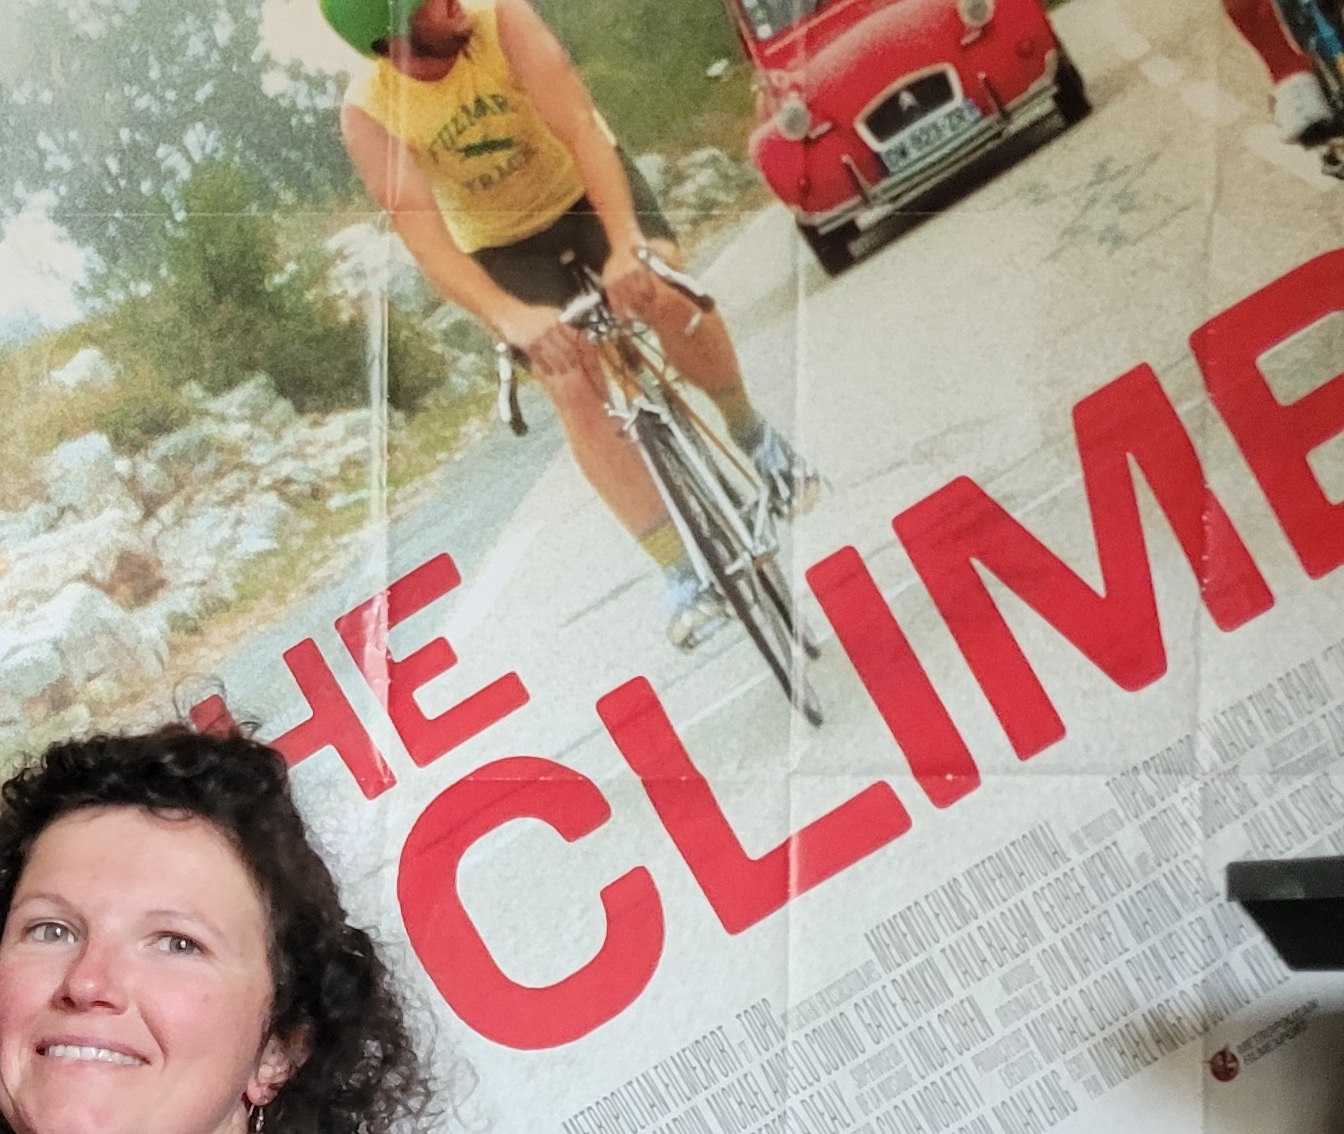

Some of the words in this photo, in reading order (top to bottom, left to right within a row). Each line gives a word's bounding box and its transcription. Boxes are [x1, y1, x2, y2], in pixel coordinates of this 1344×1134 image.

[189, 552, 530, 800] HE
[1103, 763, 1158, 824] TOPIC
[862, 899, 941, 975] MEMENTO
[923, 875, 980, 938] FILMS
[960, 818, 1072, 914] INTERNATIONAL
[1032, 941, 1078, 997] JON
[1058, 908, 1130, 980] NATCHEZ
[1114, 875, 1182, 945] MARTIN
[755, 1037, 822, 1107] ANGELO
[802, 1009, 867, 1077] COVINO
[851, 983, 909, 1047] GAYLE
[889, 954, 955, 1023] RANKIN
[938, 929, 995, 992] TALIA
[976, 897, 1046, 969] BALSAM
[1030, 866, 1097, 935] GEORGE
[1077, 839, 1139, 905] WENDT
[1023, 993, 1096, 1065] MICHAEL
[1076, 966, 1140, 1032] BLOOM
[1123, 942, 1177, 1003] RYAN
[1159, 913, 1225, 982] HELLER
[1085, 1016, 1159, 1090] MICHAEL
[1139, 985, 1210, 1058] ANGELO
[1189, 960, 1252, 1026] COVINO
[652, 1024, 745, 1109] FILMEXPORT
[734, 996, 789, 1057] TOPIC
[897, 1017, 956, 1081] LINDA
[935, 992, 995, 1057] COHEN
[1026, 1067, 1079, 1128] LANG
